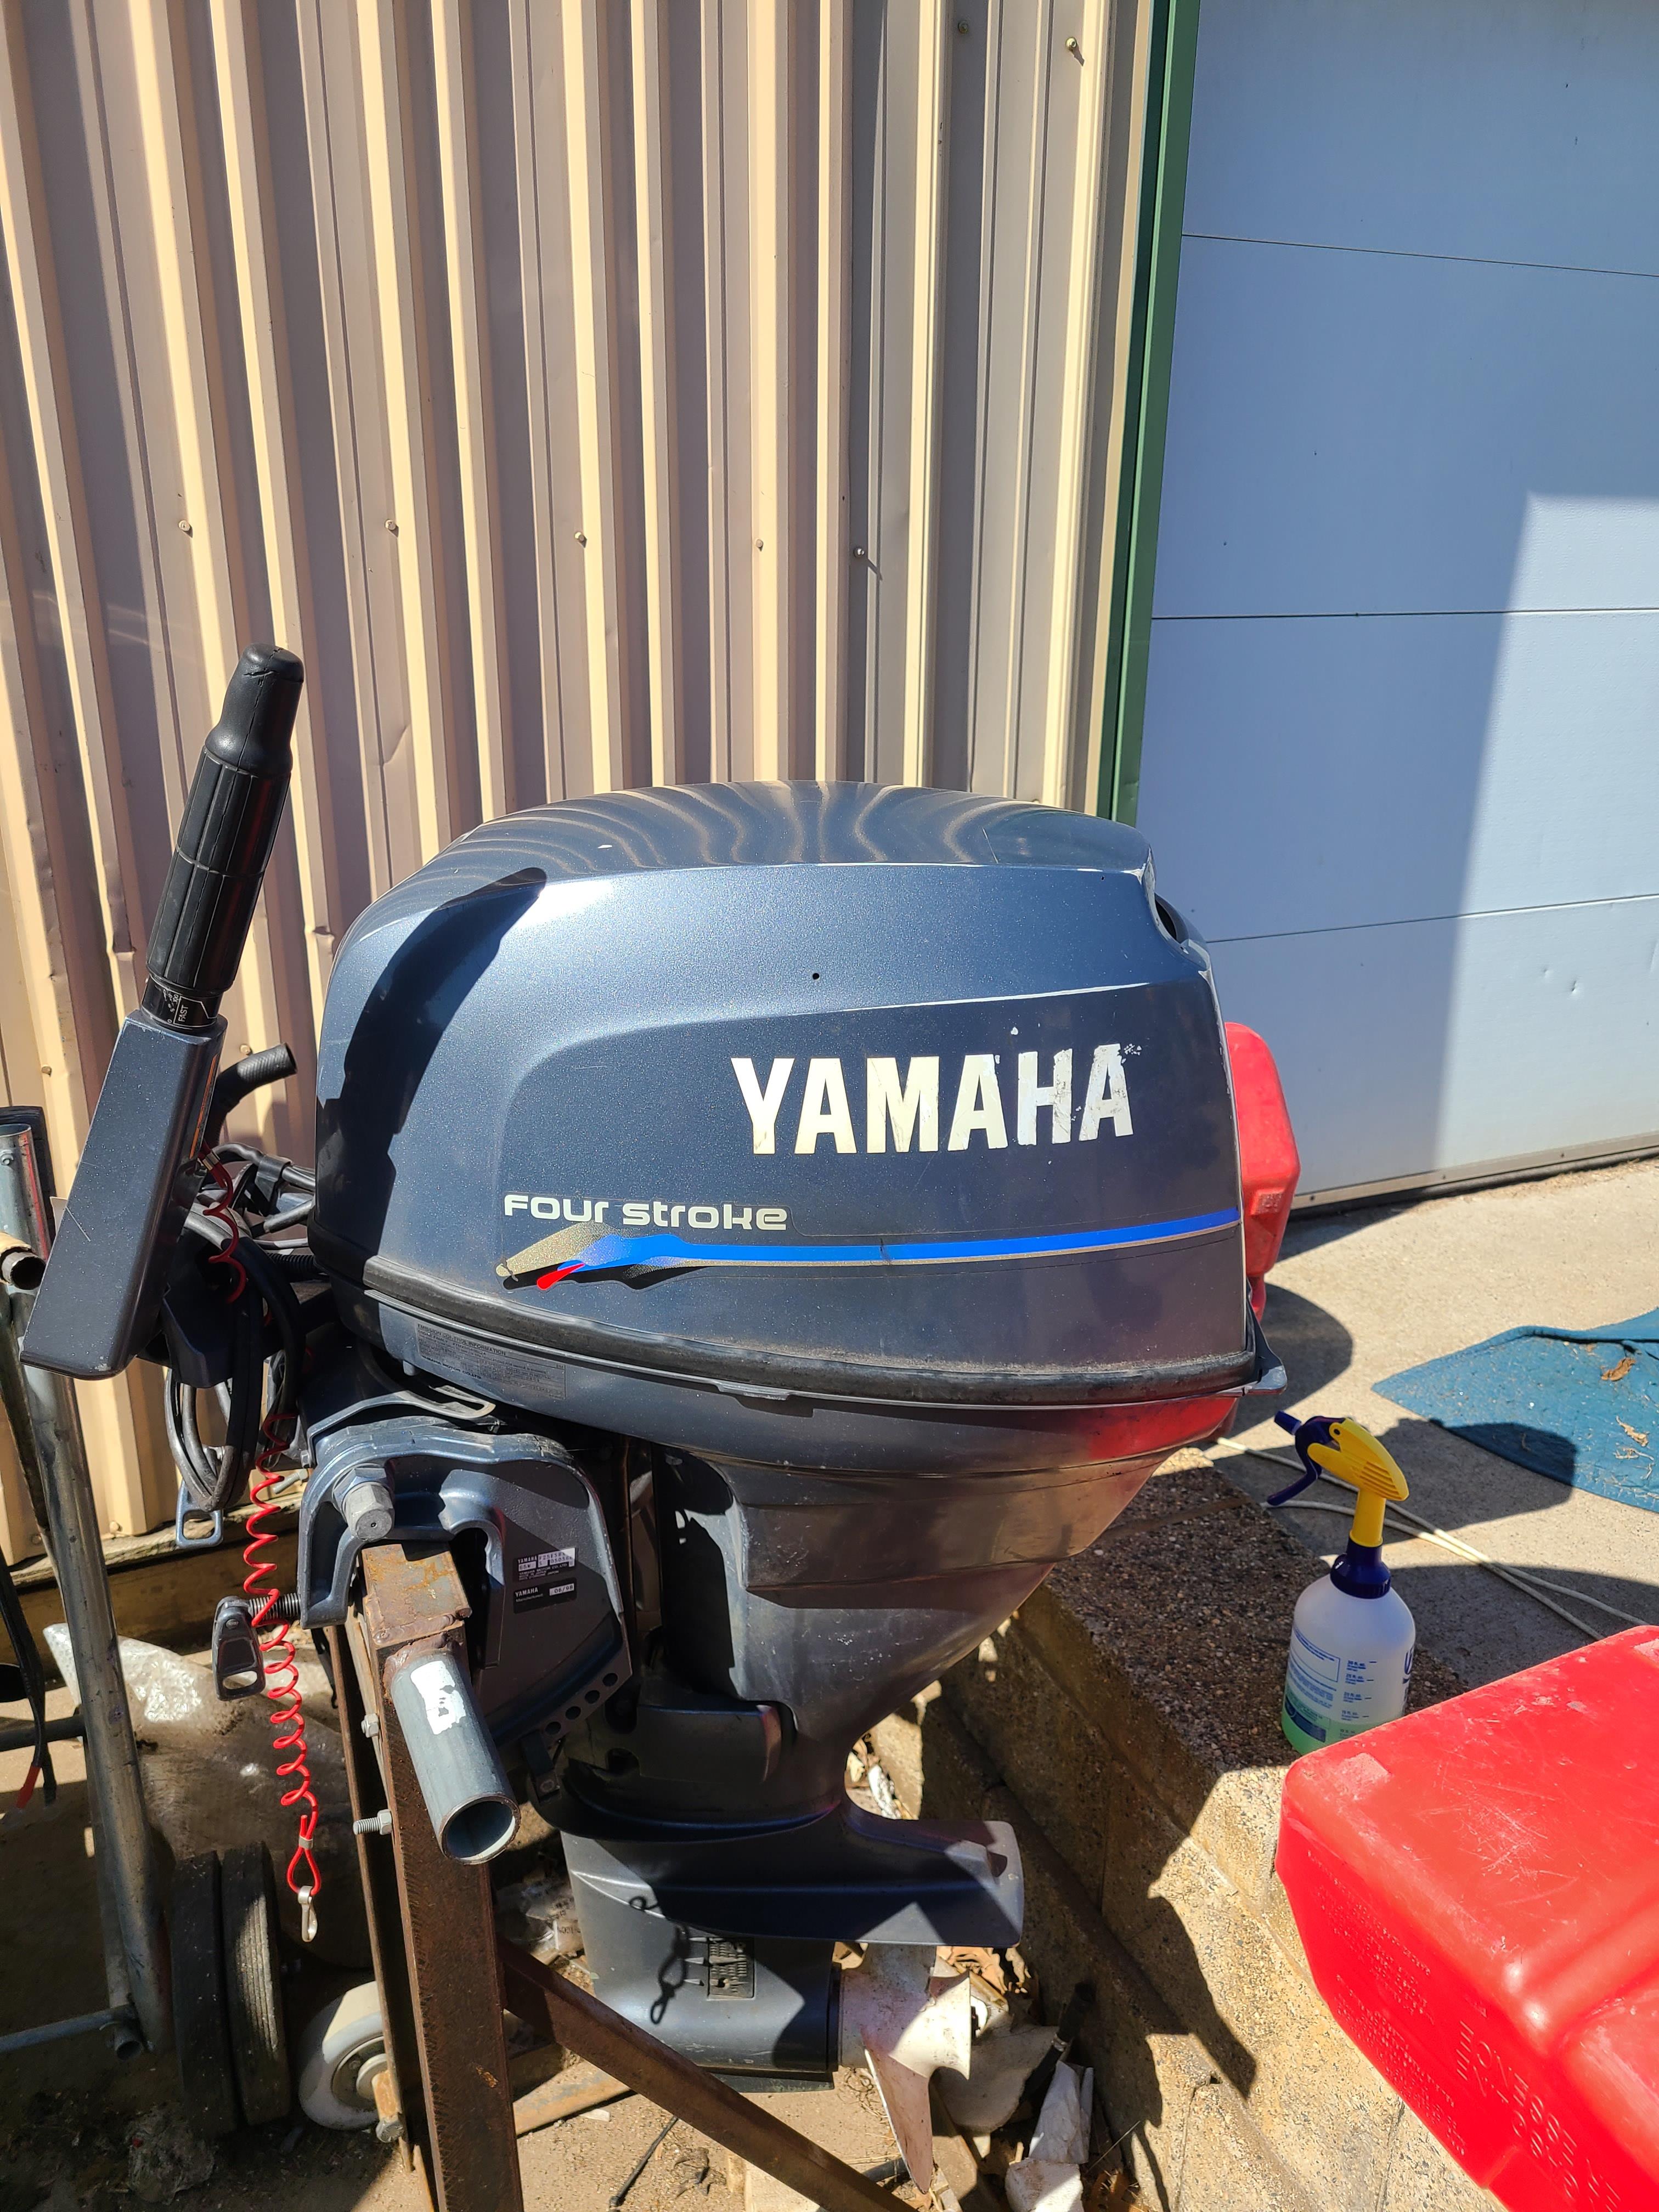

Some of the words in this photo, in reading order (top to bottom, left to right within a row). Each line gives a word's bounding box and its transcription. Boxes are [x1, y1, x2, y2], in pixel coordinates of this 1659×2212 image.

[178, 1005, 189, 1022] FAST
[730, 1043, 1134, 1155] YAMAHA
[468, 1341, 506, 1356] INFORMATION
[517, 1555, 537, 1564] YAMAHA
[515, 1587, 539, 1598] YAMAHA
